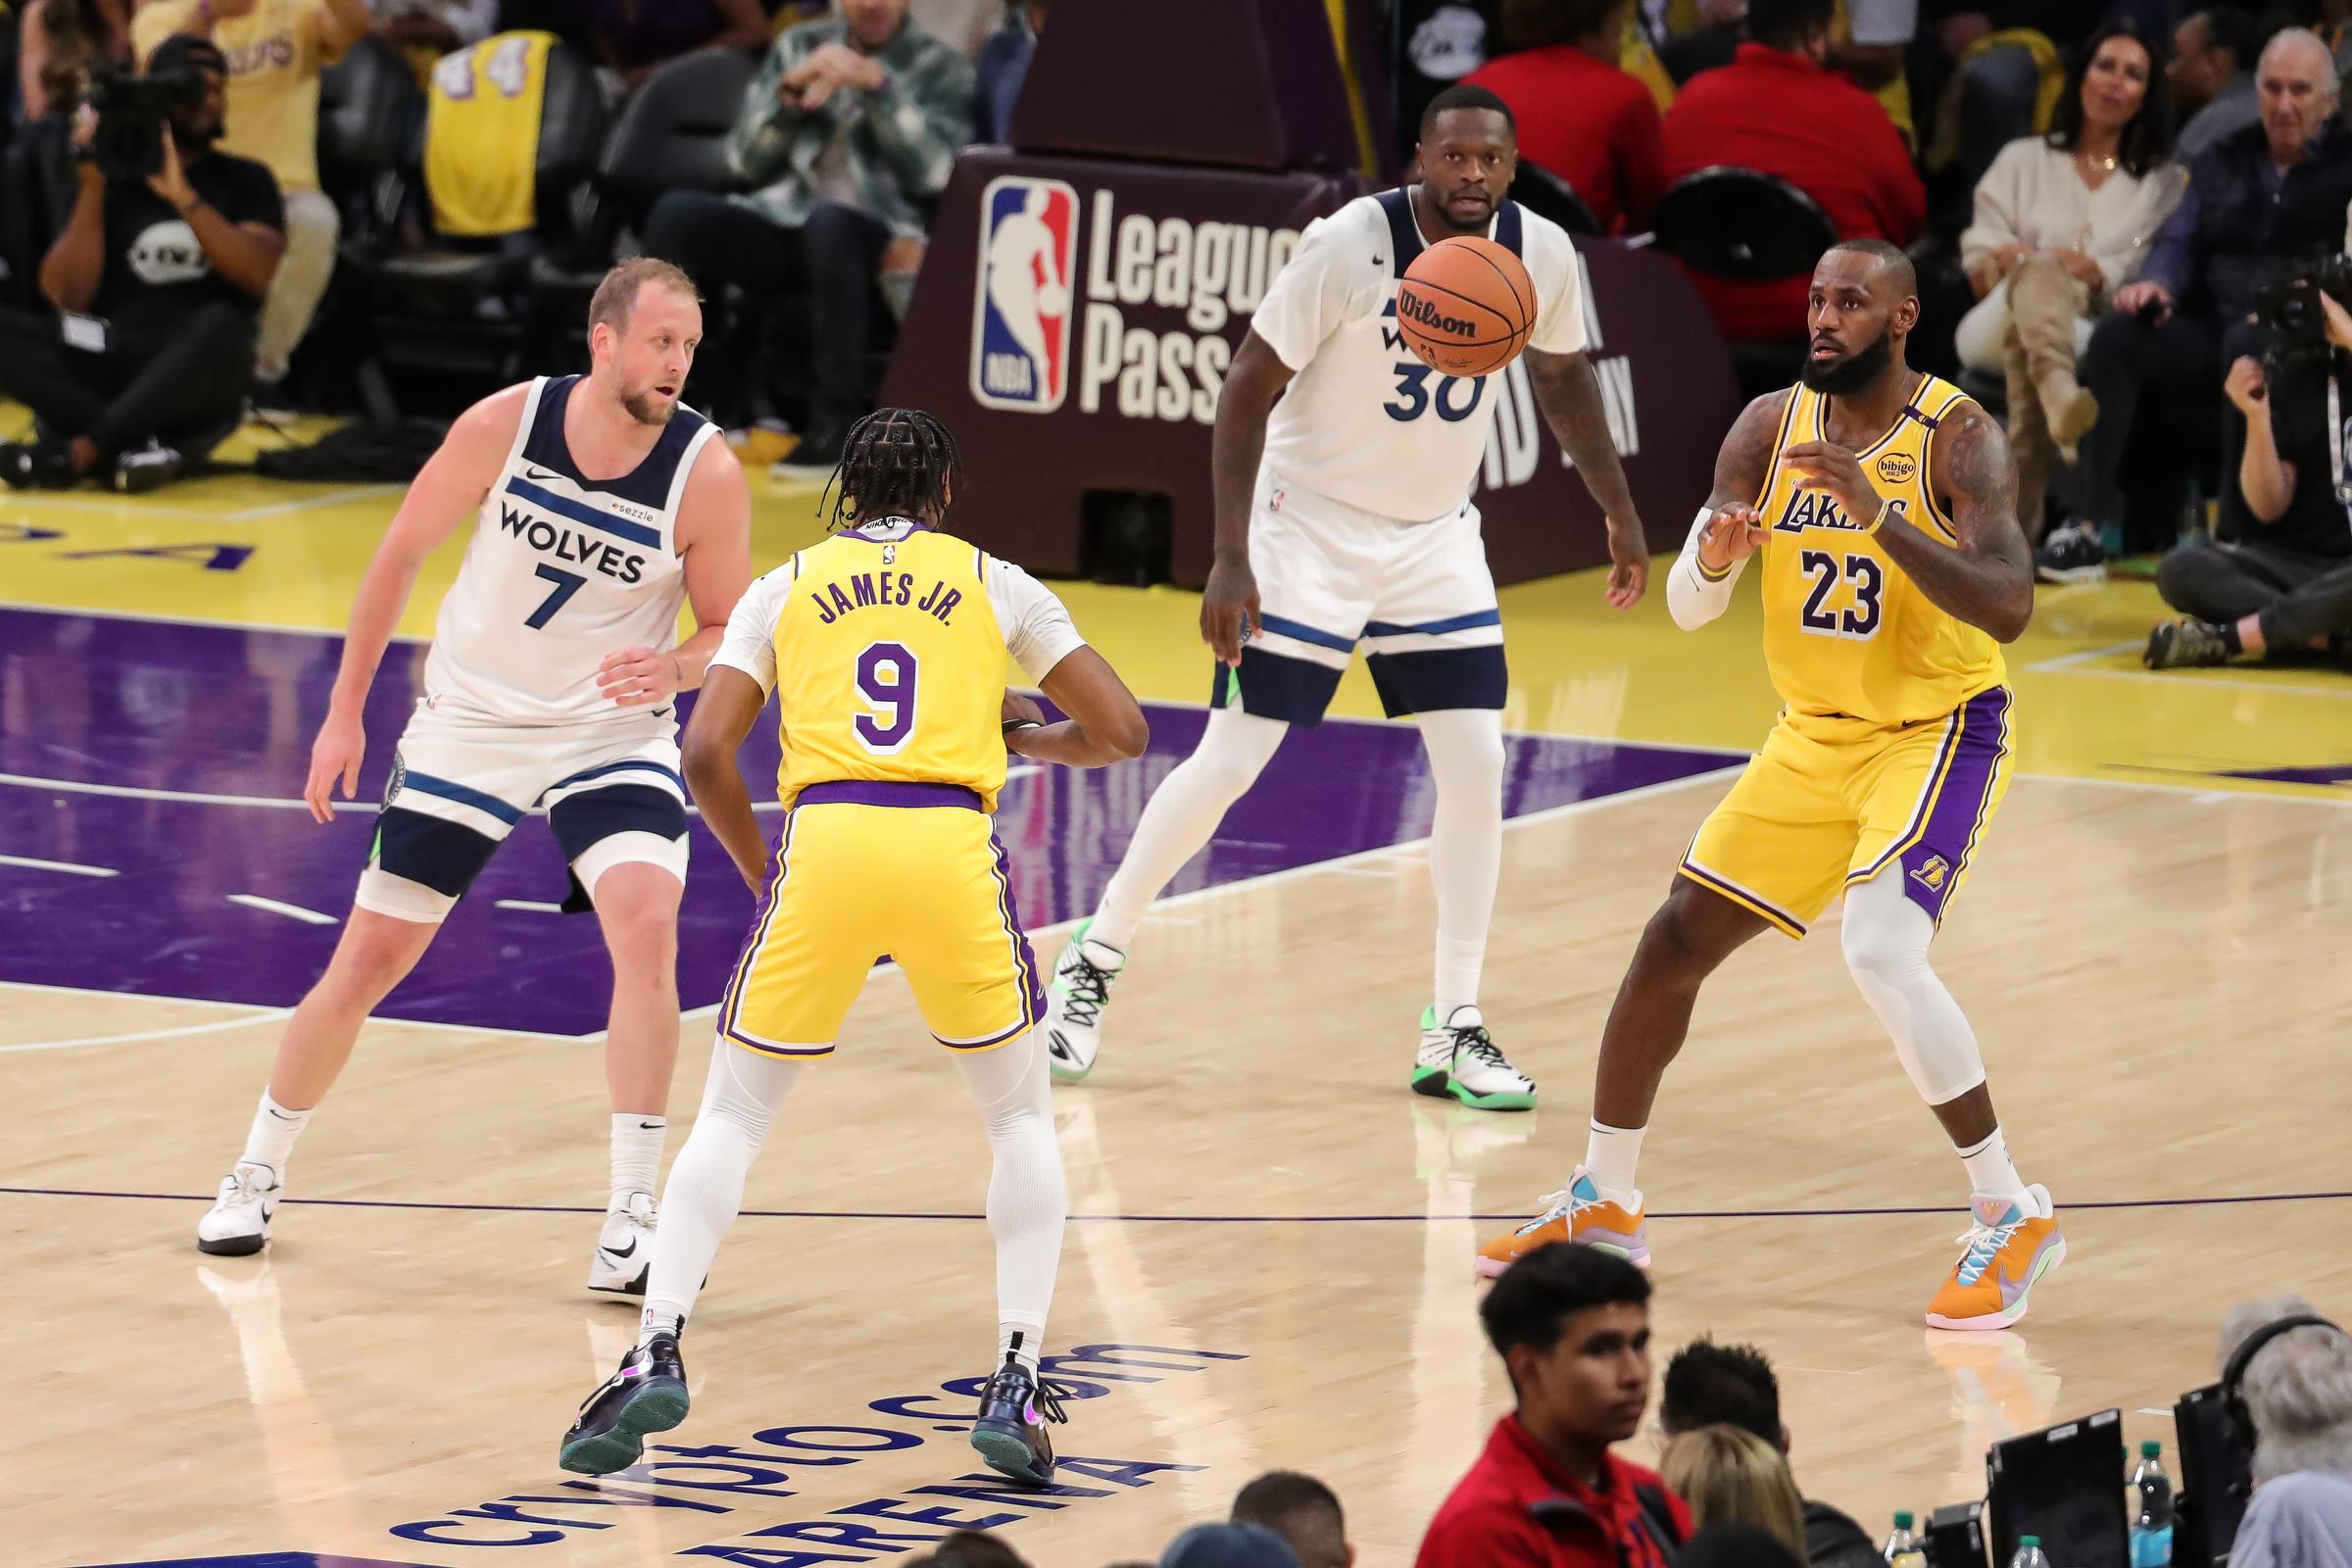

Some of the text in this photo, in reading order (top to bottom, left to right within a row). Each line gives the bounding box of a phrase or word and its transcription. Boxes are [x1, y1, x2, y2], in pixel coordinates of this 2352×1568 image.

[1400, 287, 1476, 338] Wilson
[1080, 302, 1232, 425] Pass
[1383, 362, 1488, 422] 30
[1881, 460, 1914, 475] bibigo
[619, 504, 654, 522] sezzle
[1773, 479, 1909, 533] LAK
[502, 501, 646, 584] WOLVES
[524, 562, 588, 630] 7
[811, 571, 962, 626] JAMES JR.
[1800, 549, 1884, 642] 23
[852, 640, 919, 756] 9
[389, 1345, 1250, 1546] crypto.com
[672, 1456, 1211, 1568] ARENA
